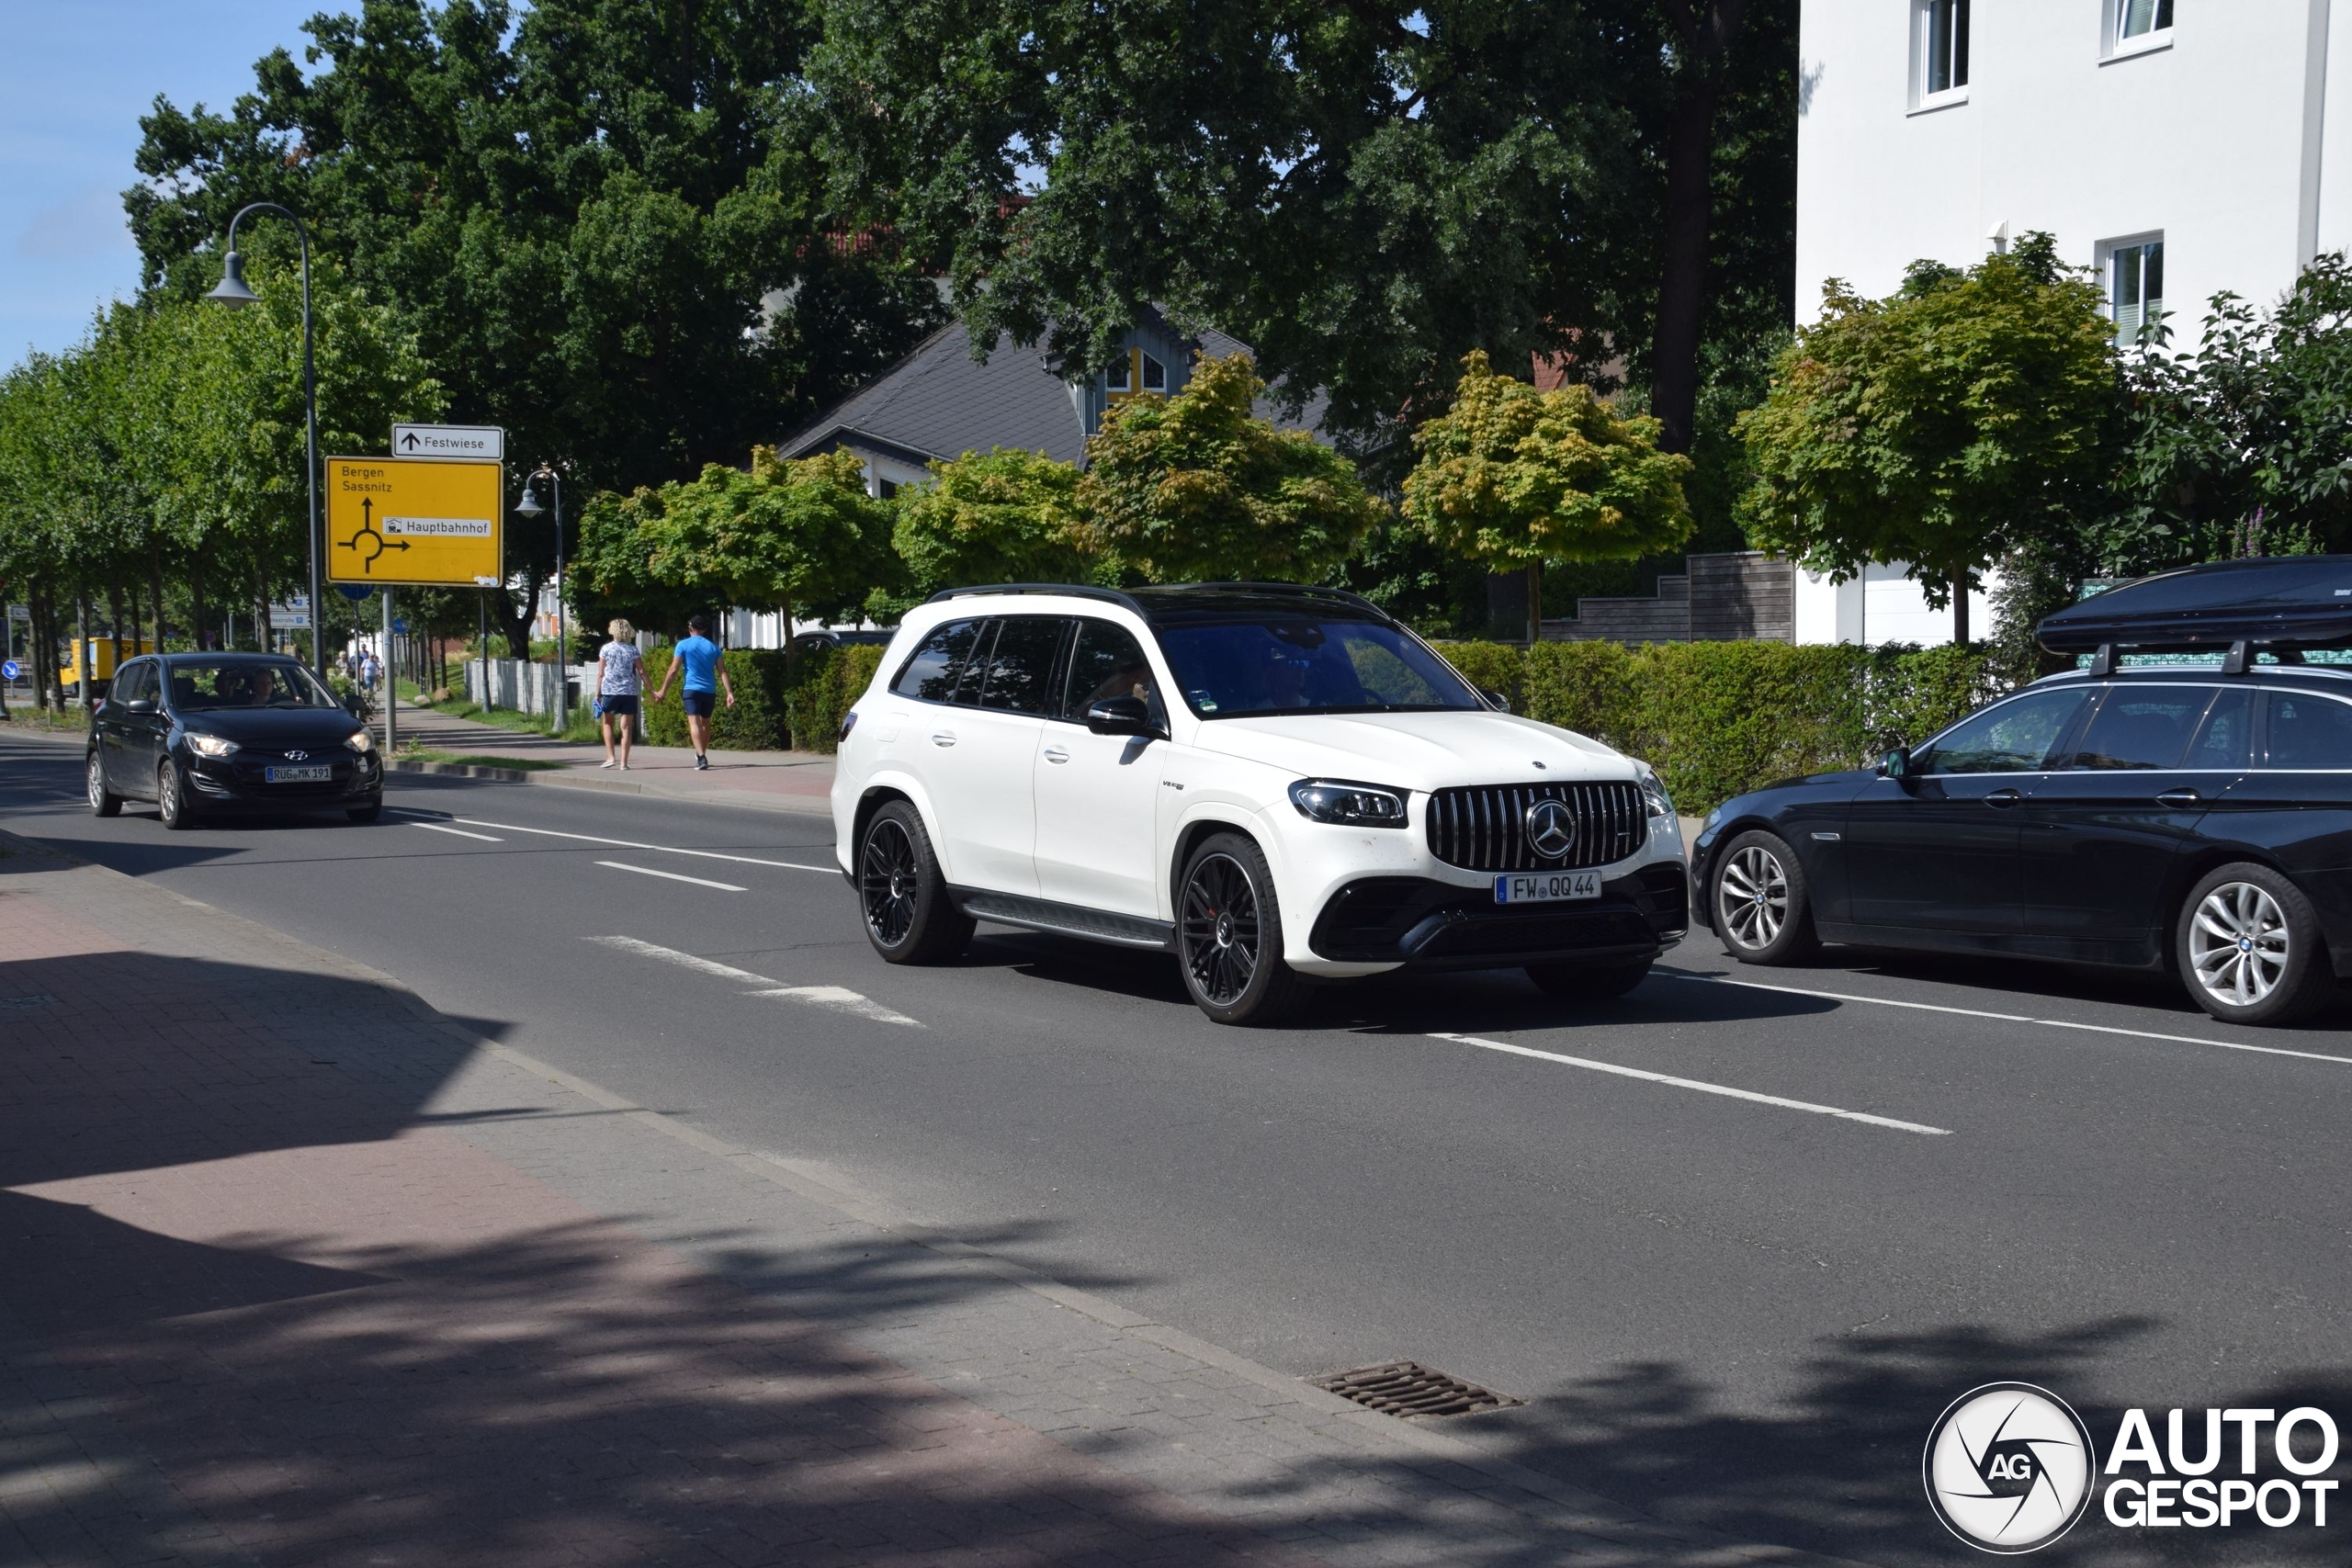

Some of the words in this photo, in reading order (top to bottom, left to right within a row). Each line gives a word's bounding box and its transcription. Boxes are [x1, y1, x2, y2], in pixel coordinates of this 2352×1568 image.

[424, 436, 484, 449] Festwiese
[342, 466, 384, 479] Bergen
[343, 481, 392, 492] Sassnitz
[407, 522, 488, 535] Hauptbahnhof
[274, 769, 293, 780] RÜG
[298, 768, 311, 779] MK
[312, 768, 330, 778] 191
[1513, 878, 1537, 898] FW
[1549, 876, 1571, 897] QQ
[1575, 874, 1595, 896] 44
